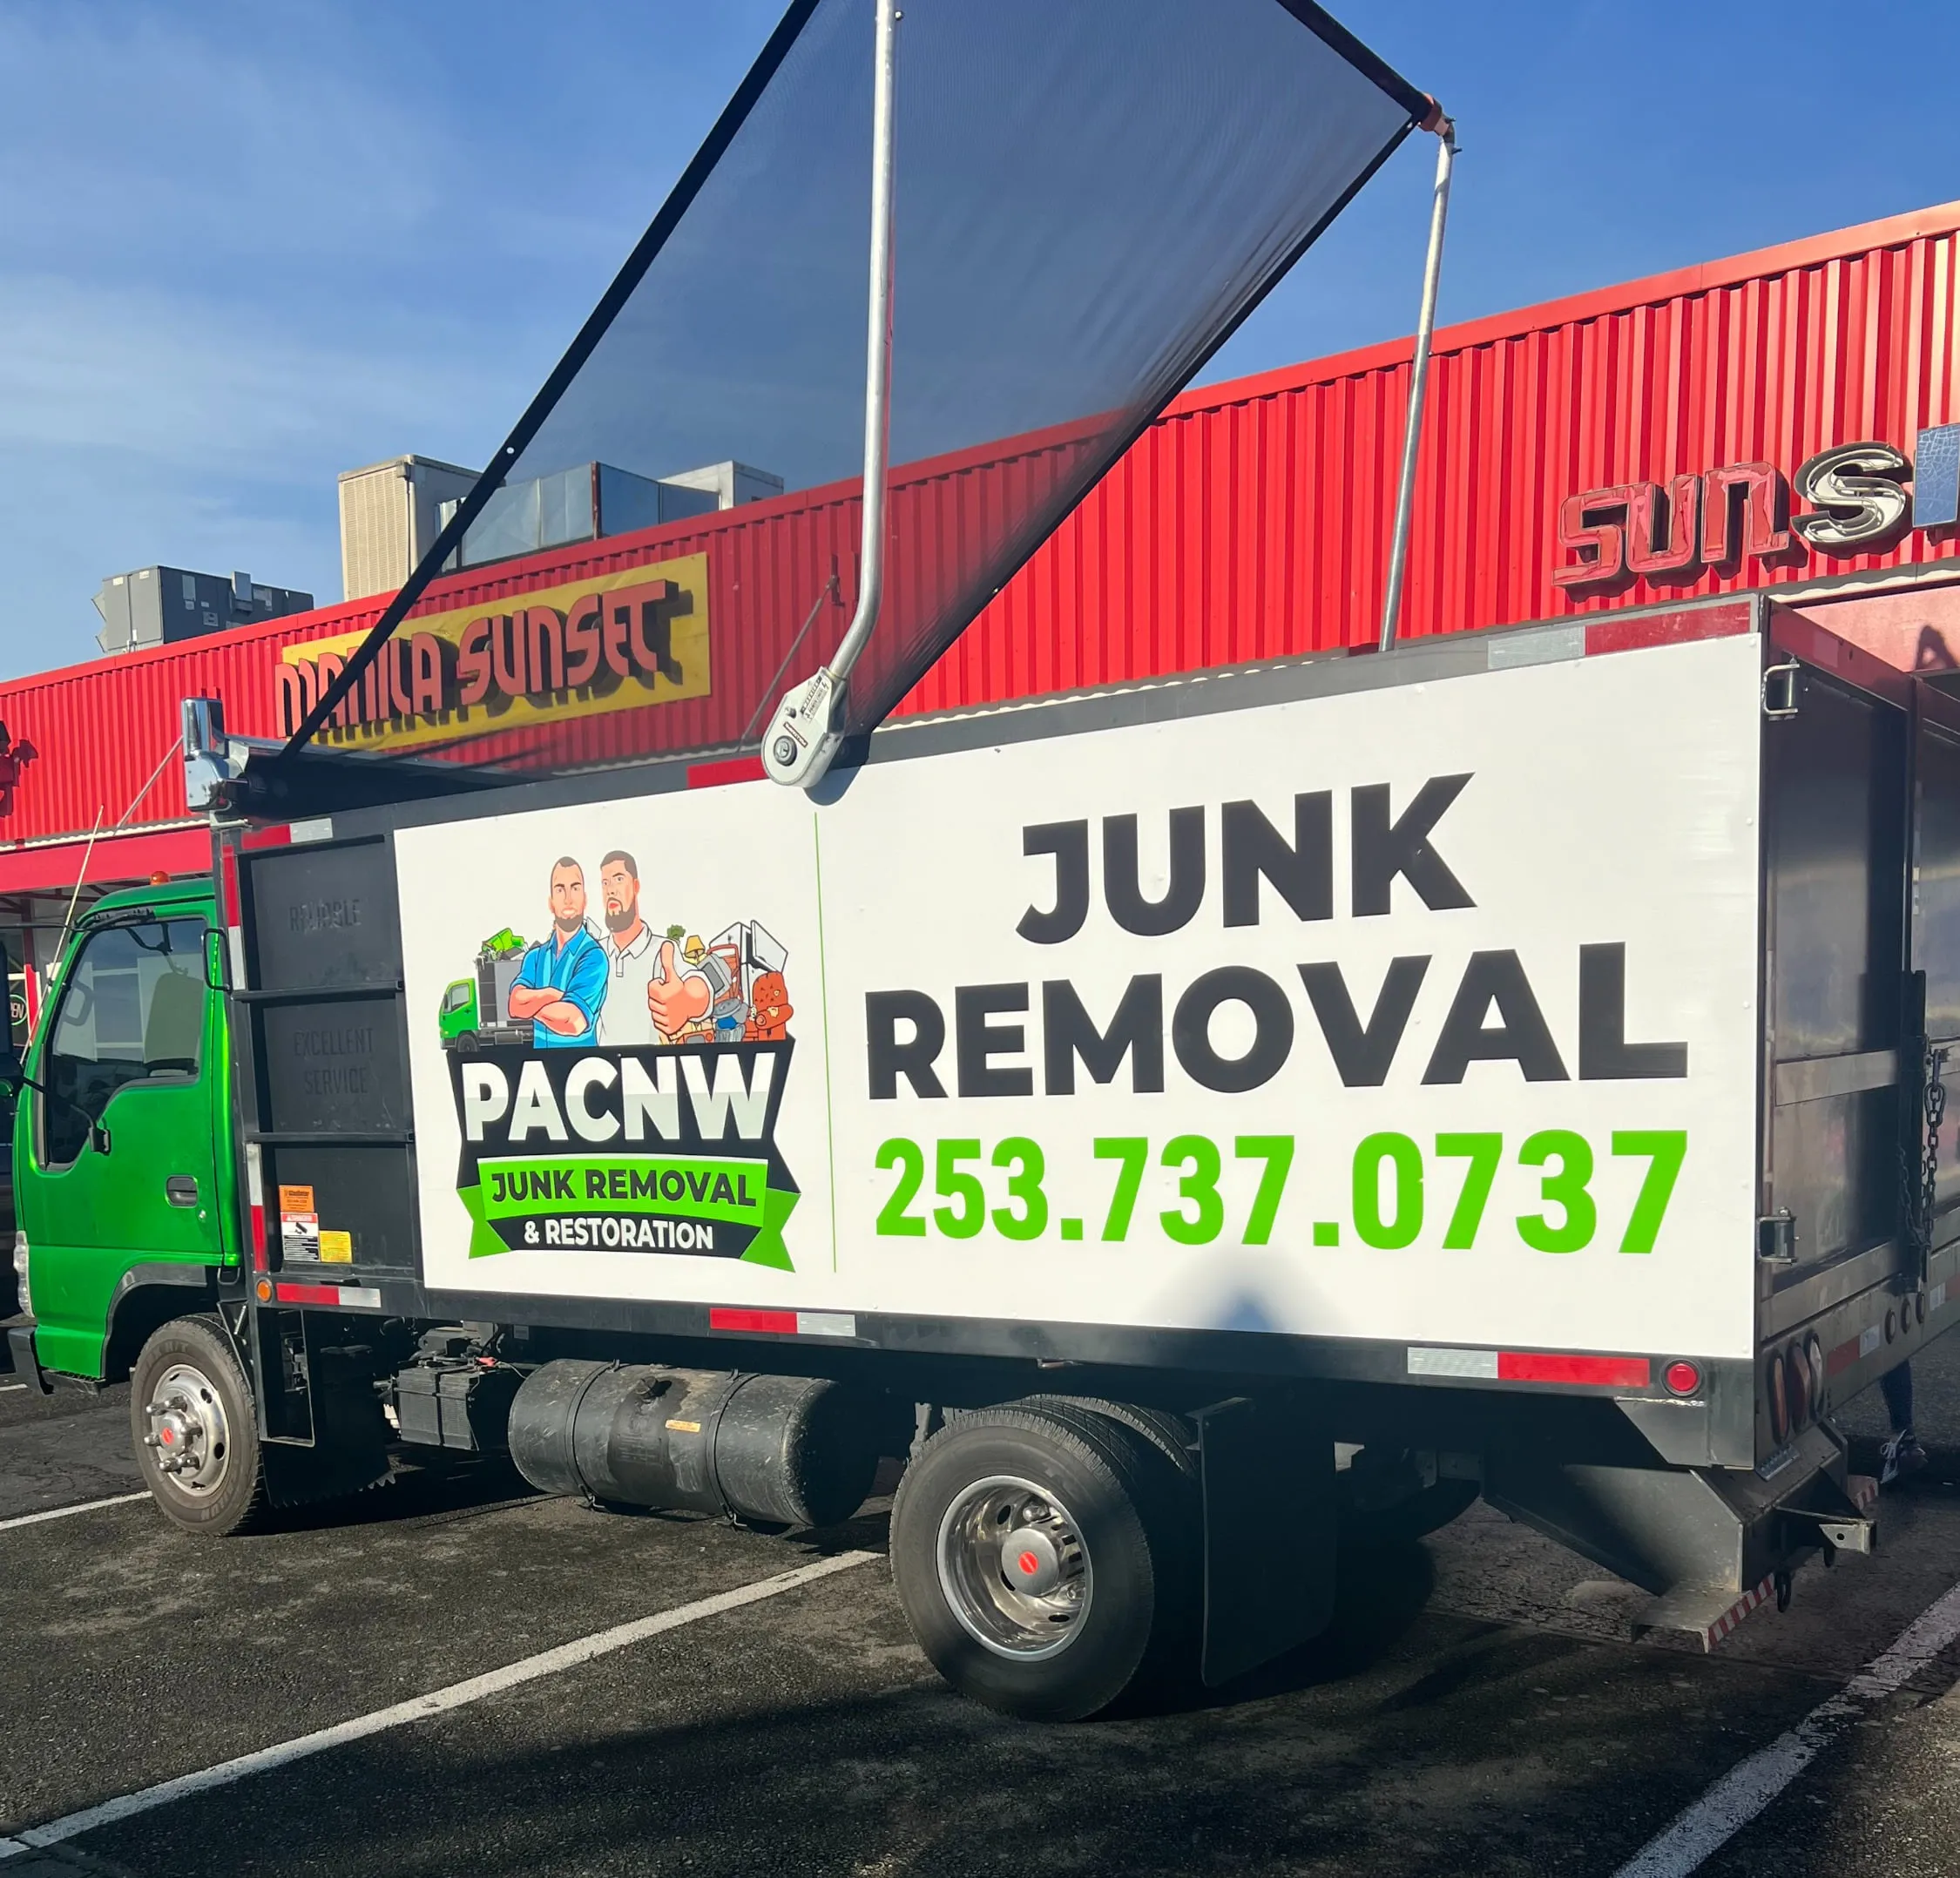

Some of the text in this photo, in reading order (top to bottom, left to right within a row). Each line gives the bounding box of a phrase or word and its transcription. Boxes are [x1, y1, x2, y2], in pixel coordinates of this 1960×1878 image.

[456, 579, 669, 706] SUNSET
[1015, 772, 1478, 945] JUNK
[294, 1027, 374, 1057] EXCELLENT
[865, 942, 1687, 1100] REMOVAL
[304, 1066, 368, 1096] SERVICE
[462, 1052, 776, 1142] PACNW
[491, 1169, 757, 1207] JUNK REMOVAL
[875, 1130, 1687, 1253] 253.737.0737
[524, 1217, 713, 1250] & RESTORATION
